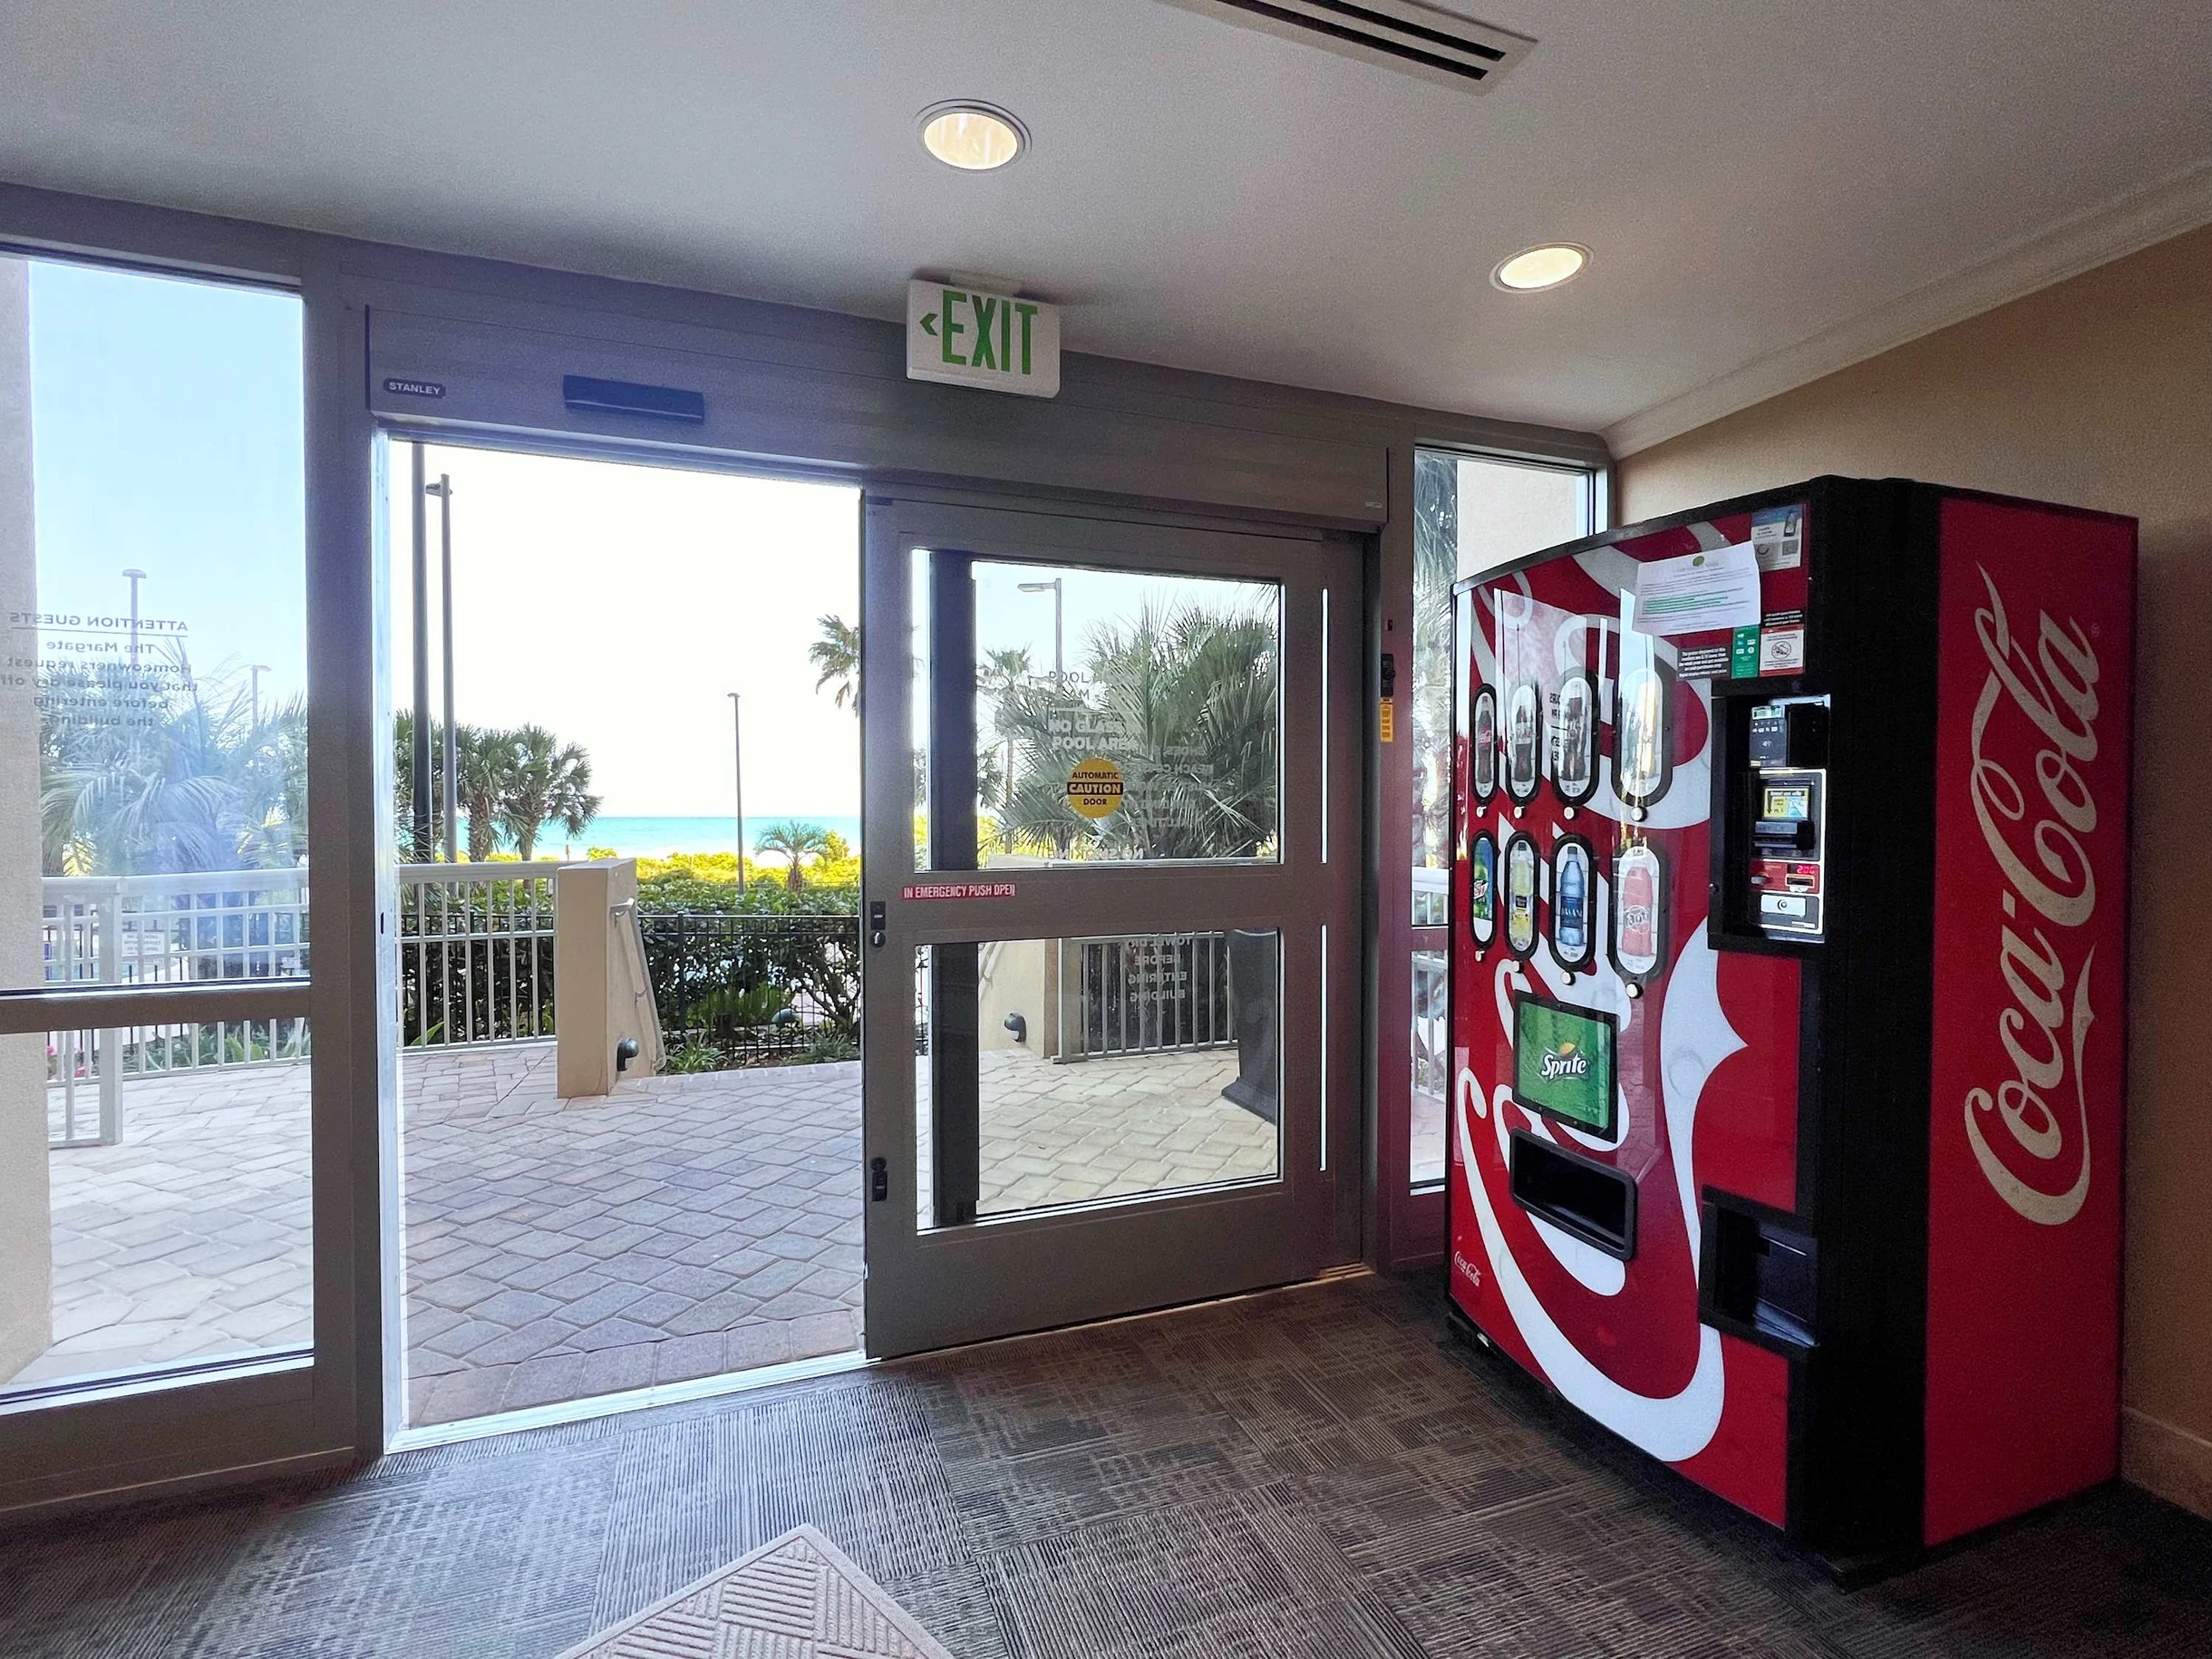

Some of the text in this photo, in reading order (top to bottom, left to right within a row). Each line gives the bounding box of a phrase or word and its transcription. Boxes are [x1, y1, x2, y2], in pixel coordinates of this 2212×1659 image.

[942, 289, 1038, 375] EXIT
[388, 382, 441, 394] STANLEY
[1053, 735, 1095, 752] POOL
[1072, 771, 1119, 780] AUTOMATIC
[1069, 783, 1121, 794] CAUTION
[904, 883, 1015, 898] IN EMERGENCY PUSH OPEN
[1964, 560, 2100, 1226] Coca-Cola
[1541, 1053, 1587, 1080] Sprite
